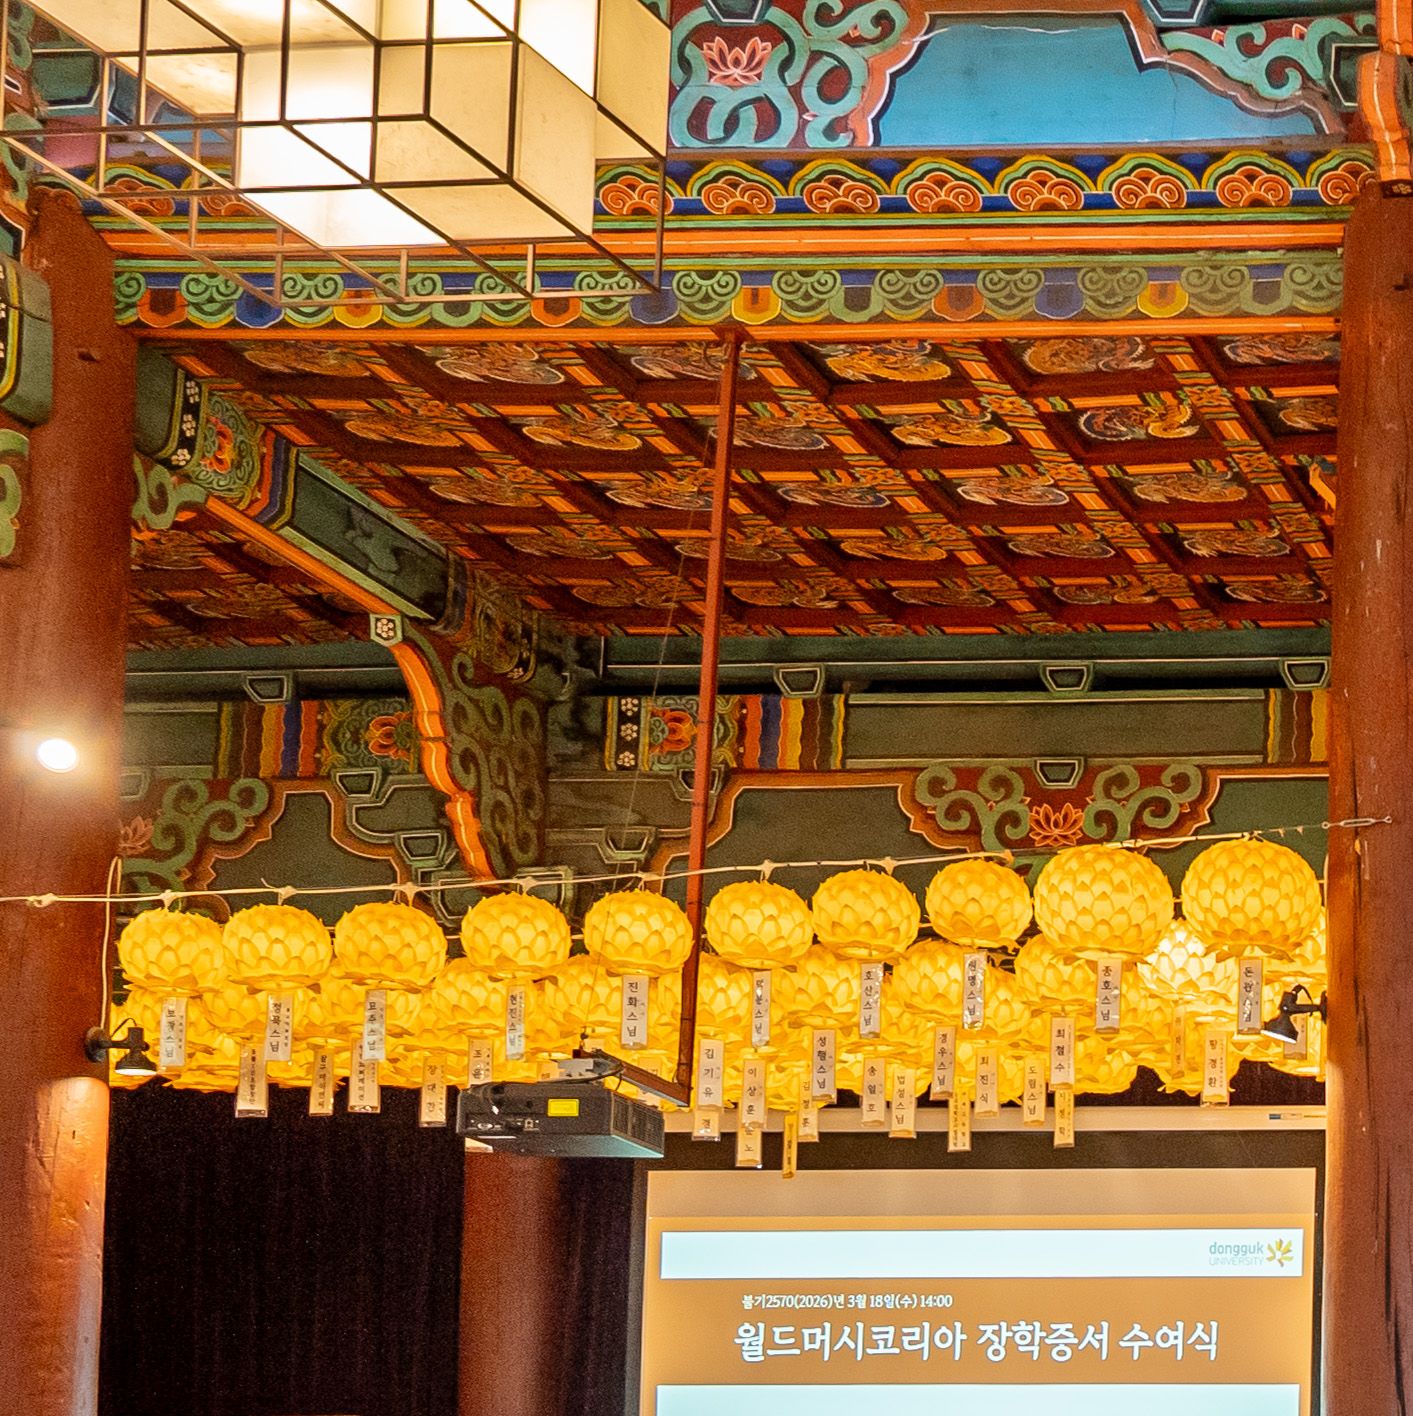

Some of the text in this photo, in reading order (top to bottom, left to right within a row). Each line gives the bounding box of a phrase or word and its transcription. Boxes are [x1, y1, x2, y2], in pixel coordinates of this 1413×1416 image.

[626, 981, 639, 1038] 진화스님
[703, 1048, 715, 1098] 김기유
[1209, 1241, 1264, 1257] dongguk
[1209, 1256, 1264, 1266] UNIVERSITY
[741, 1293, 953, 1310] 불기2570(2026)년 3월 18일(수) 14:00
[733, 1320, 1219, 1363] 월드머시코리아 장학증서 수여식
